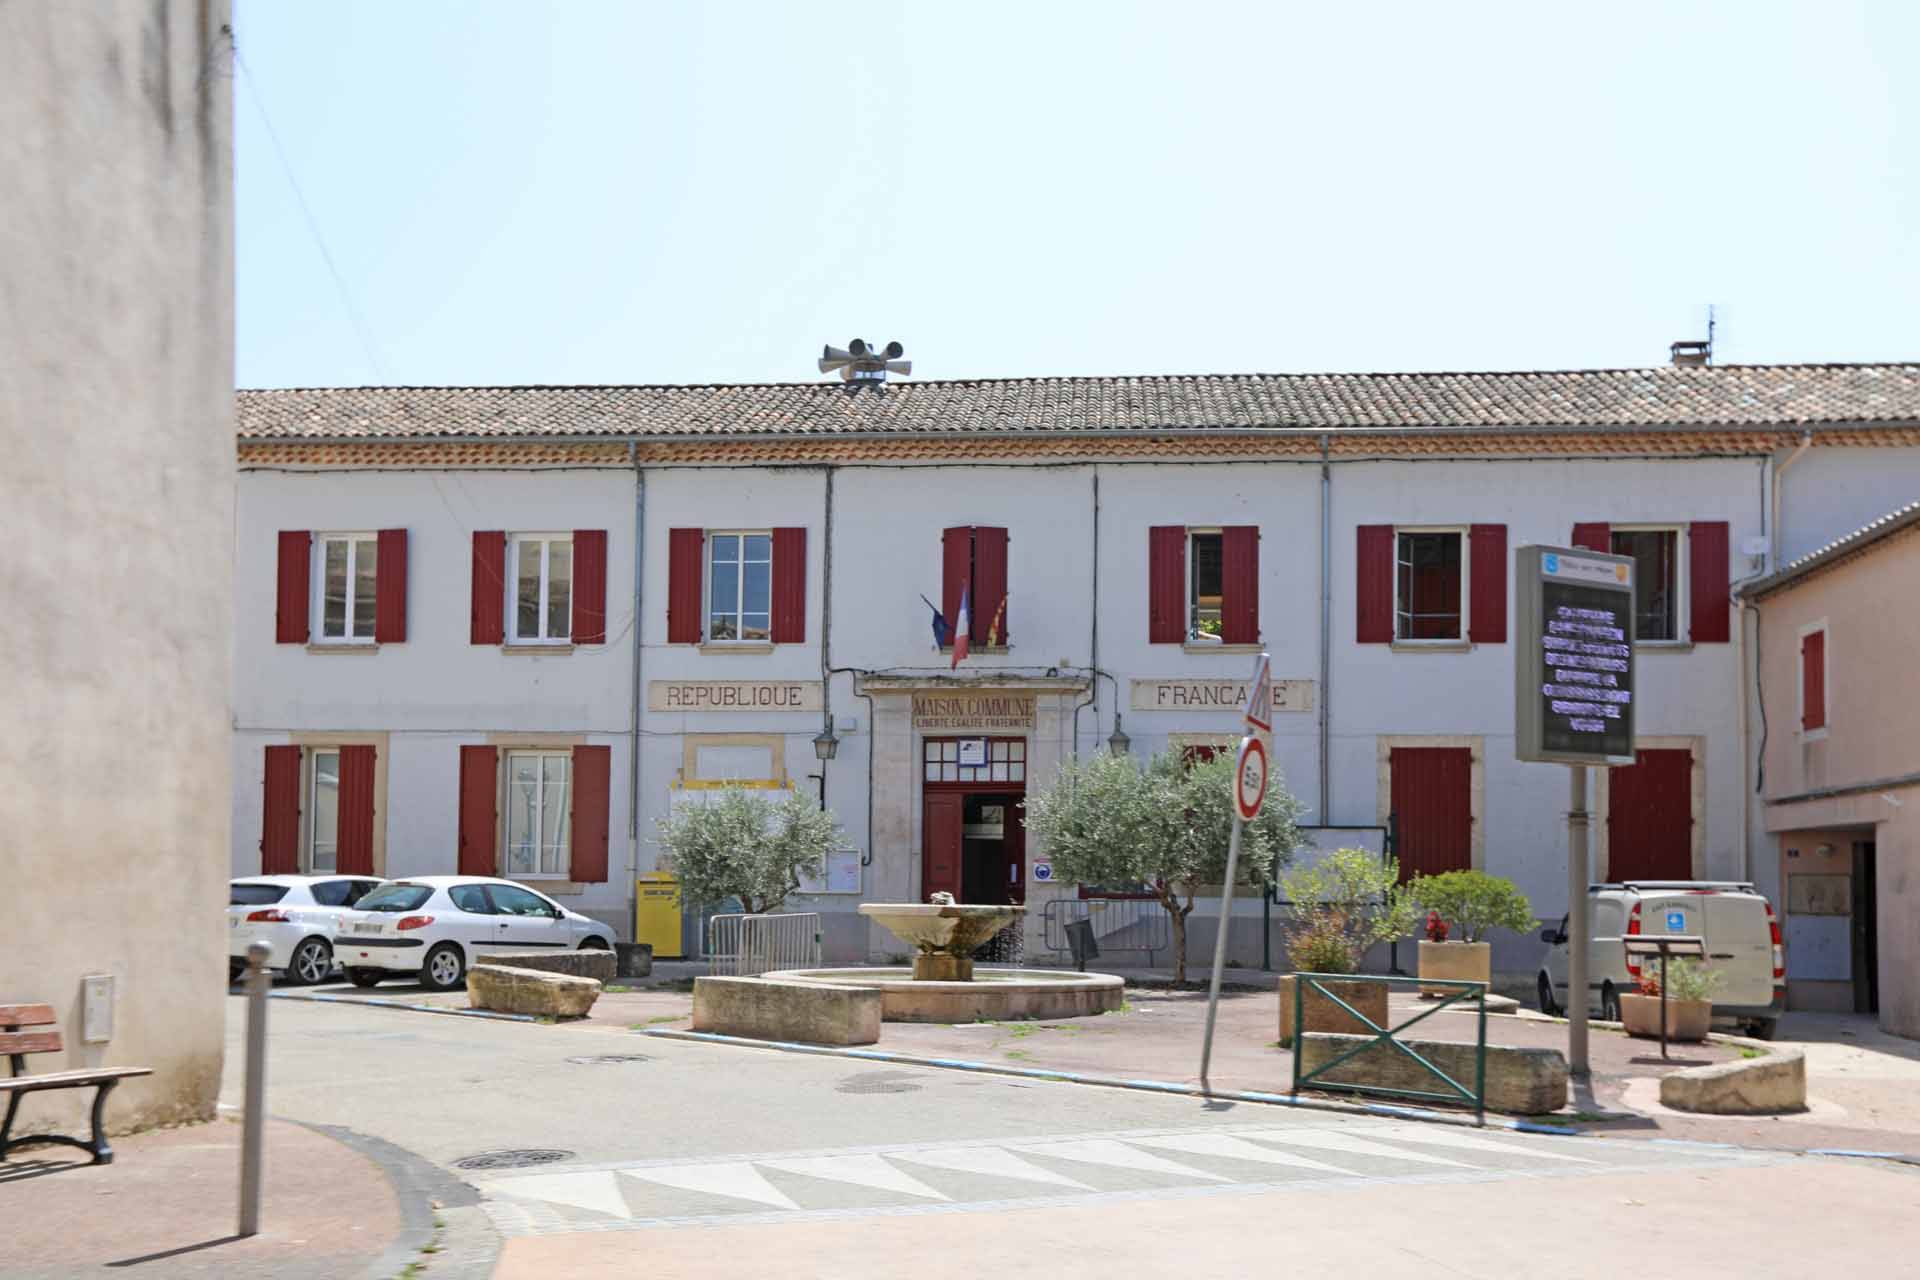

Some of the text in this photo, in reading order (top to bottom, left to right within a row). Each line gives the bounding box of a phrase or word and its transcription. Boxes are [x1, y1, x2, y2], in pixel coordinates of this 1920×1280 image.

[667, 686, 803, 706] REPUBLIQUE
[1157, 685, 1287, 705] FRANCAE
[913, 697, 1034, 717] MAISON COMMUNE
